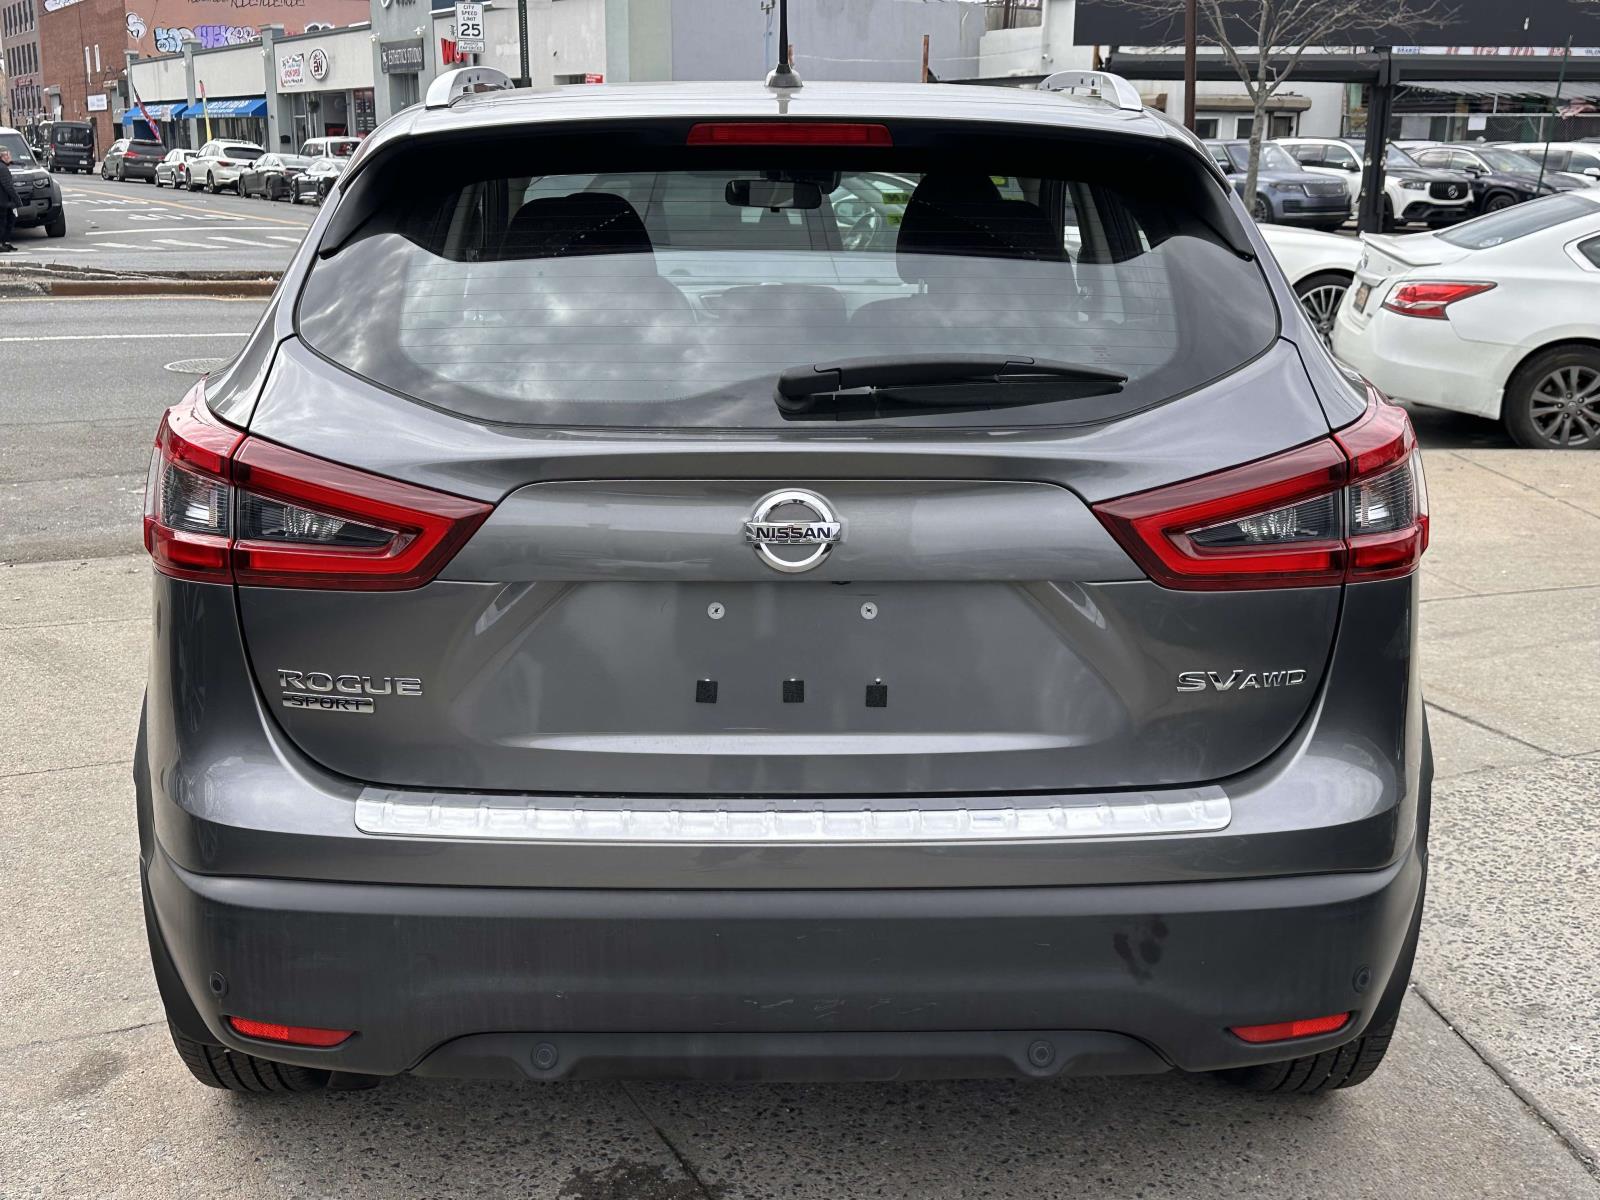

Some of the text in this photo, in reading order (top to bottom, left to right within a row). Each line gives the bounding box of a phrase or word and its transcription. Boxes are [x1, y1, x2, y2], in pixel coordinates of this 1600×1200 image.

[460, 23, 481, 37] 25
[755, 527, 831, 539] NISSAN
[277, 668, 423, 696] ROGUE
[291, 695, 365, 711] SPORT
